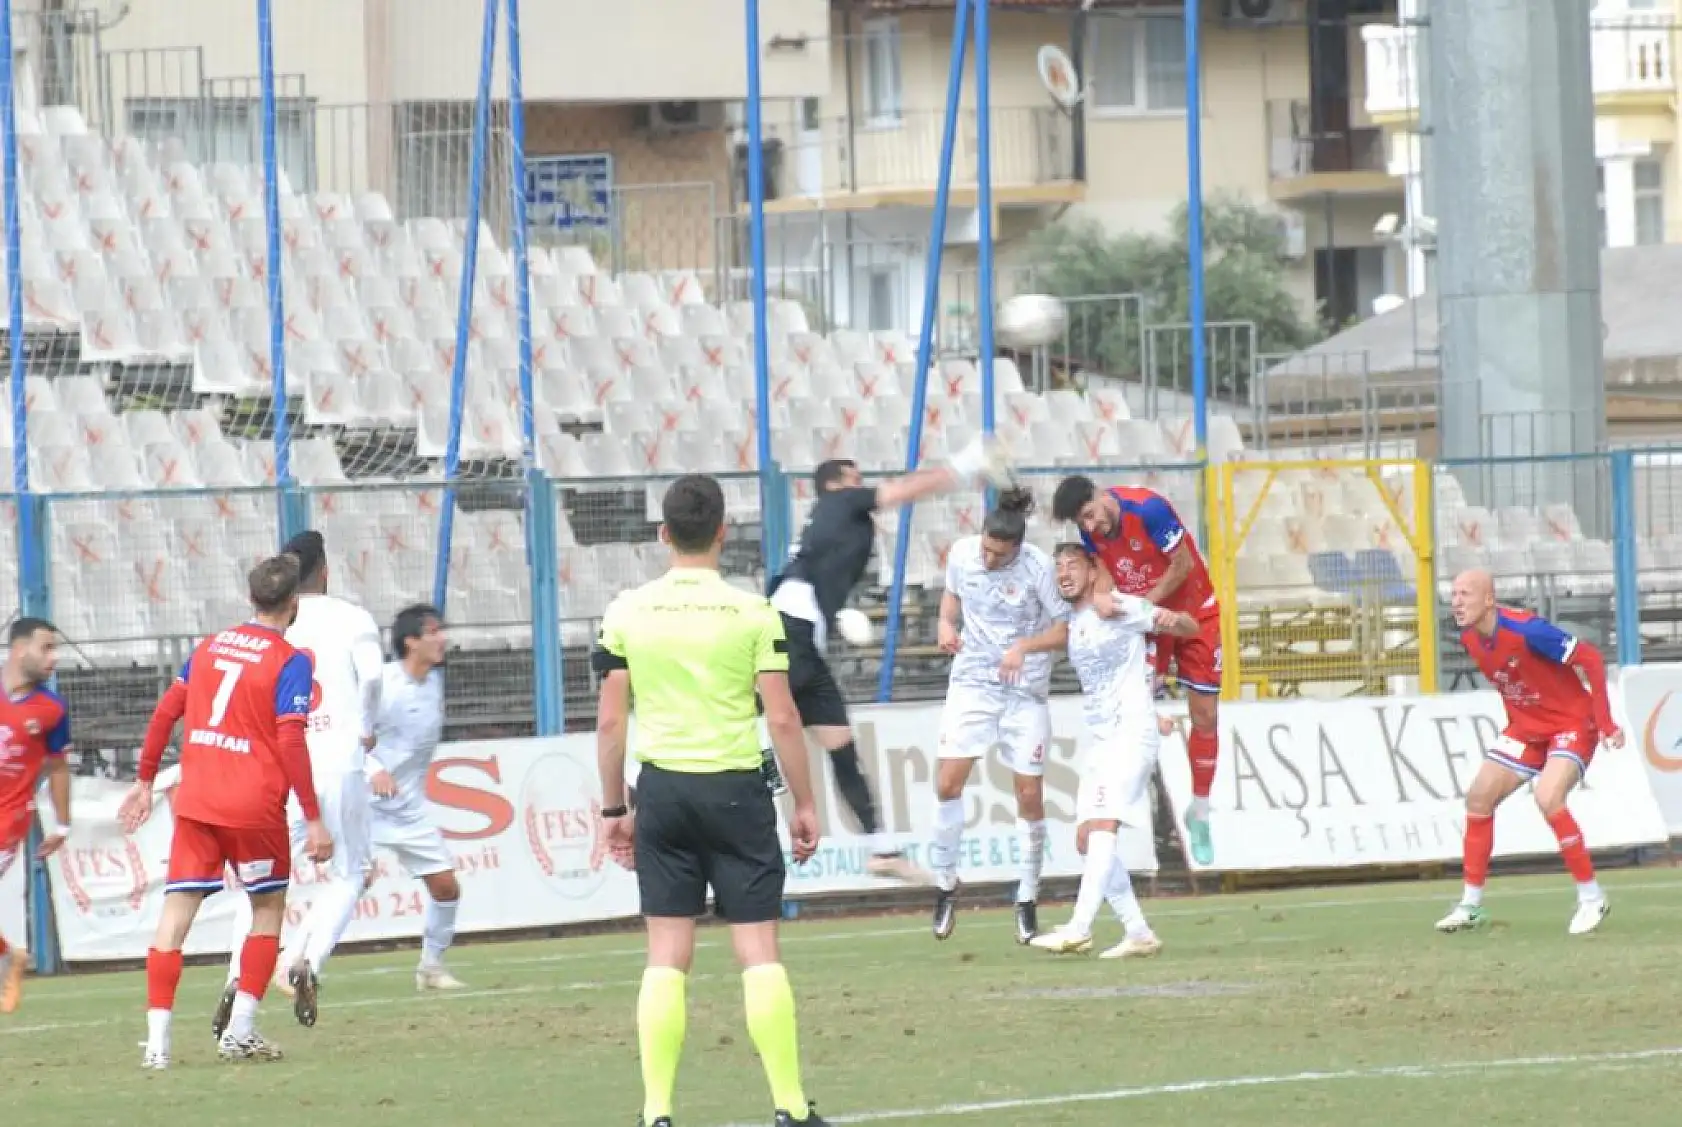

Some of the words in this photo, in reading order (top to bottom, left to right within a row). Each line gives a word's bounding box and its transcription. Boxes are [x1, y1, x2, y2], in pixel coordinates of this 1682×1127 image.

[208, 658, 245, 728] 7
[988, 836, 1004, 867] &
[389, 892, 423, 917] 24
